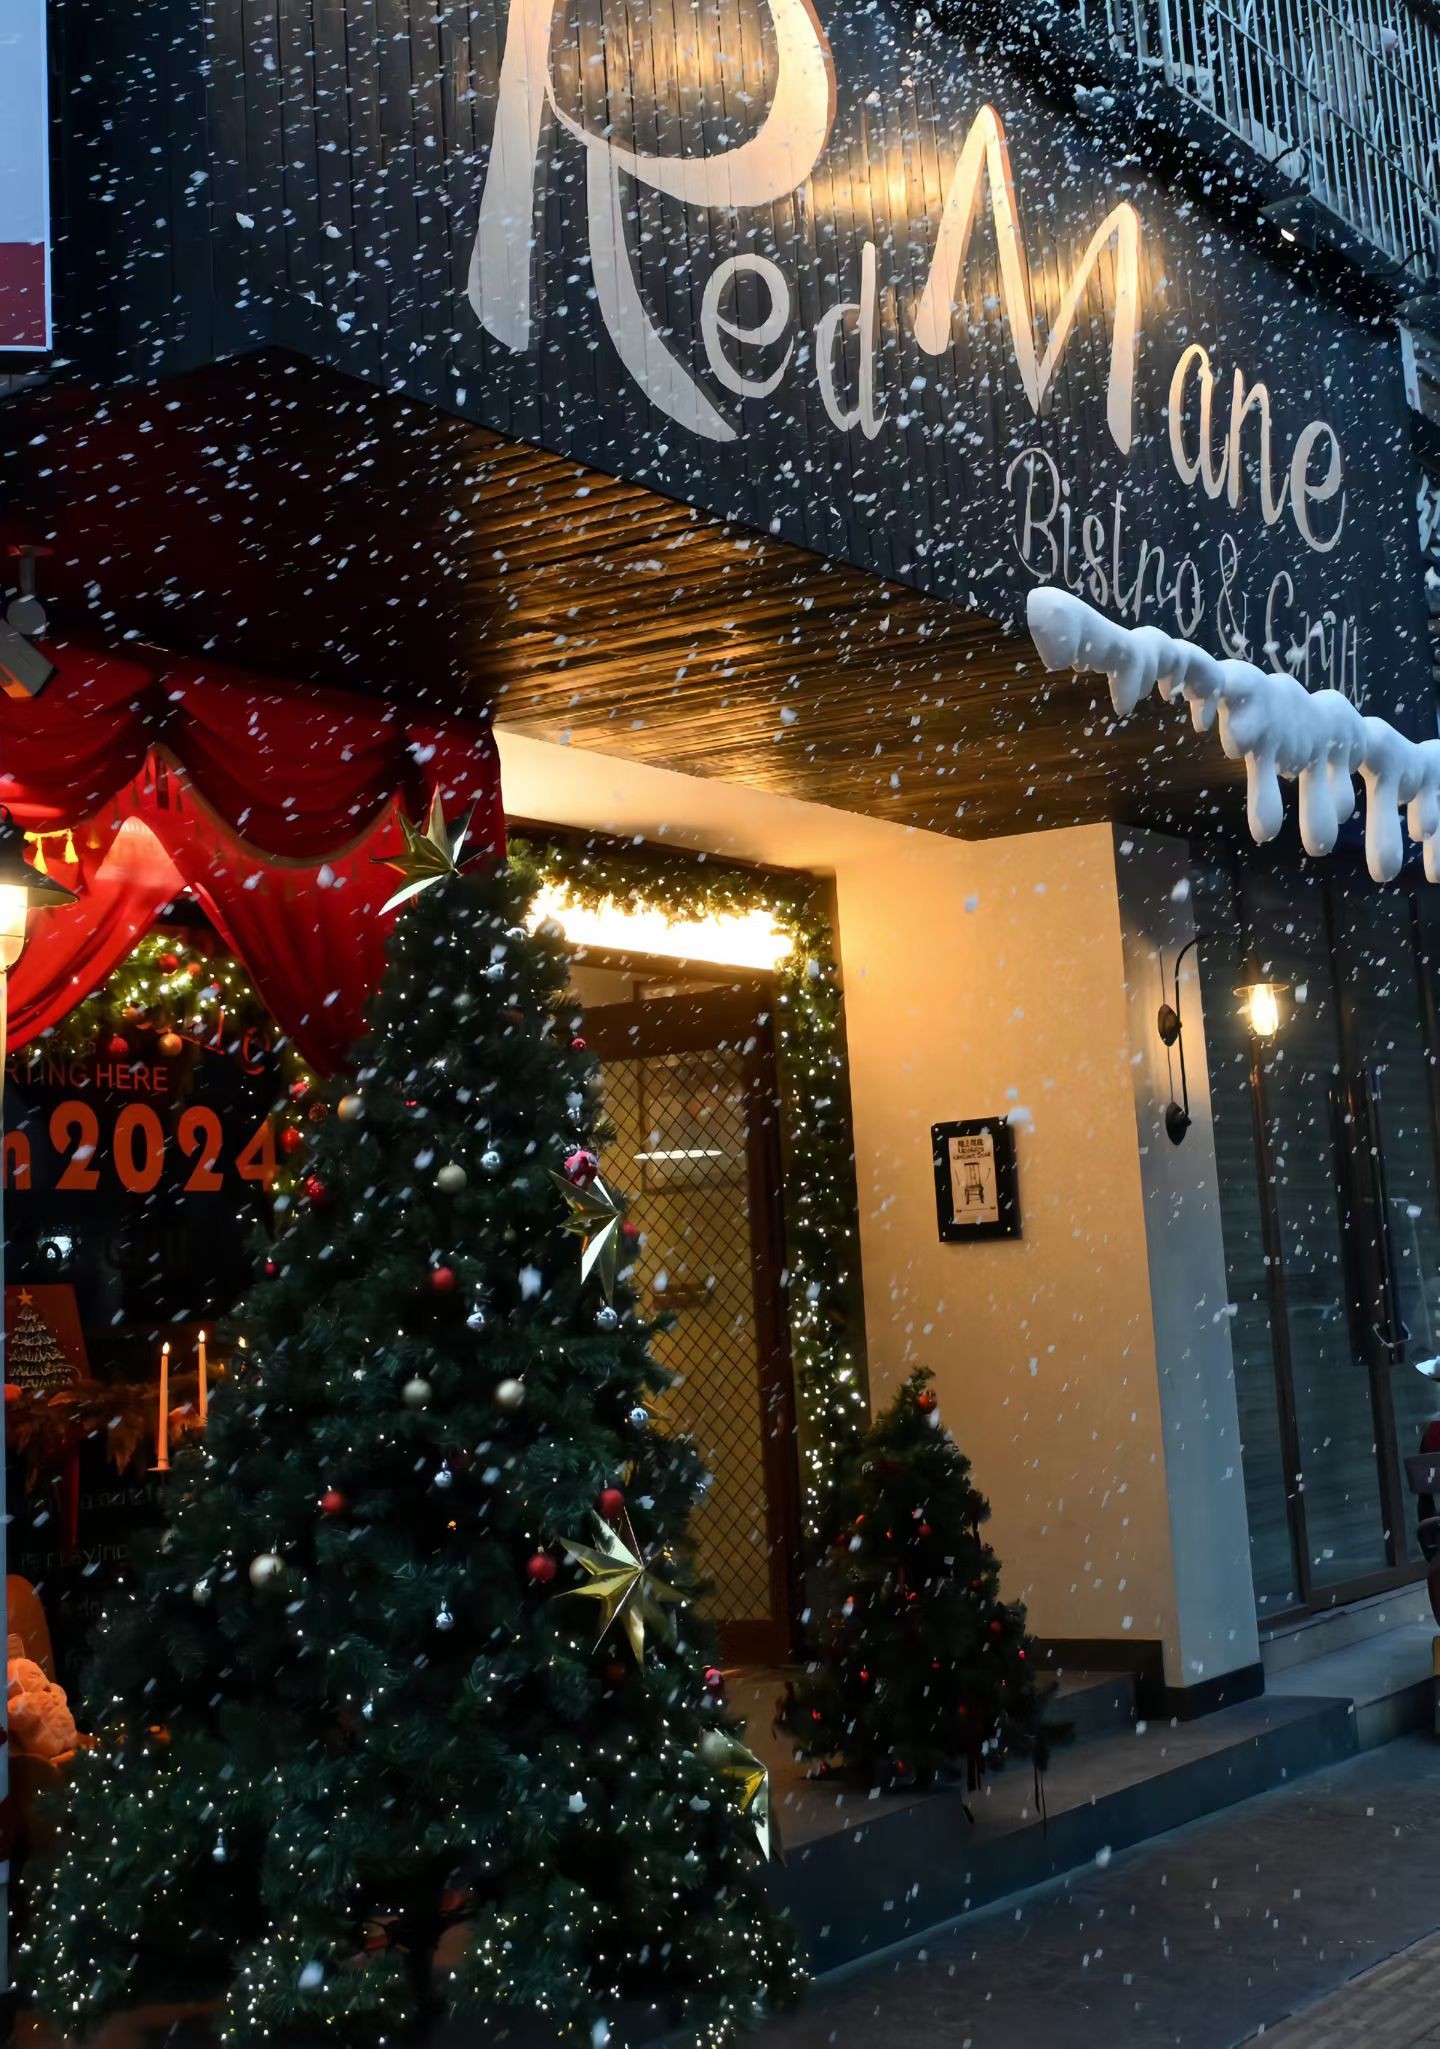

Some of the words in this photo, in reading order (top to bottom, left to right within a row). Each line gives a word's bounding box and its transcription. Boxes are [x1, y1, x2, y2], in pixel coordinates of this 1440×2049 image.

[467, 0, 888, 442] Red
[913, 103, 1347, 553] Mane
[1005, 447, 1205, 638] Bistro
[1216, 533, 1254, 662] &
[50, 1100, 279, 1194] 2024
[96, 1063, 169, 1092] HERE
